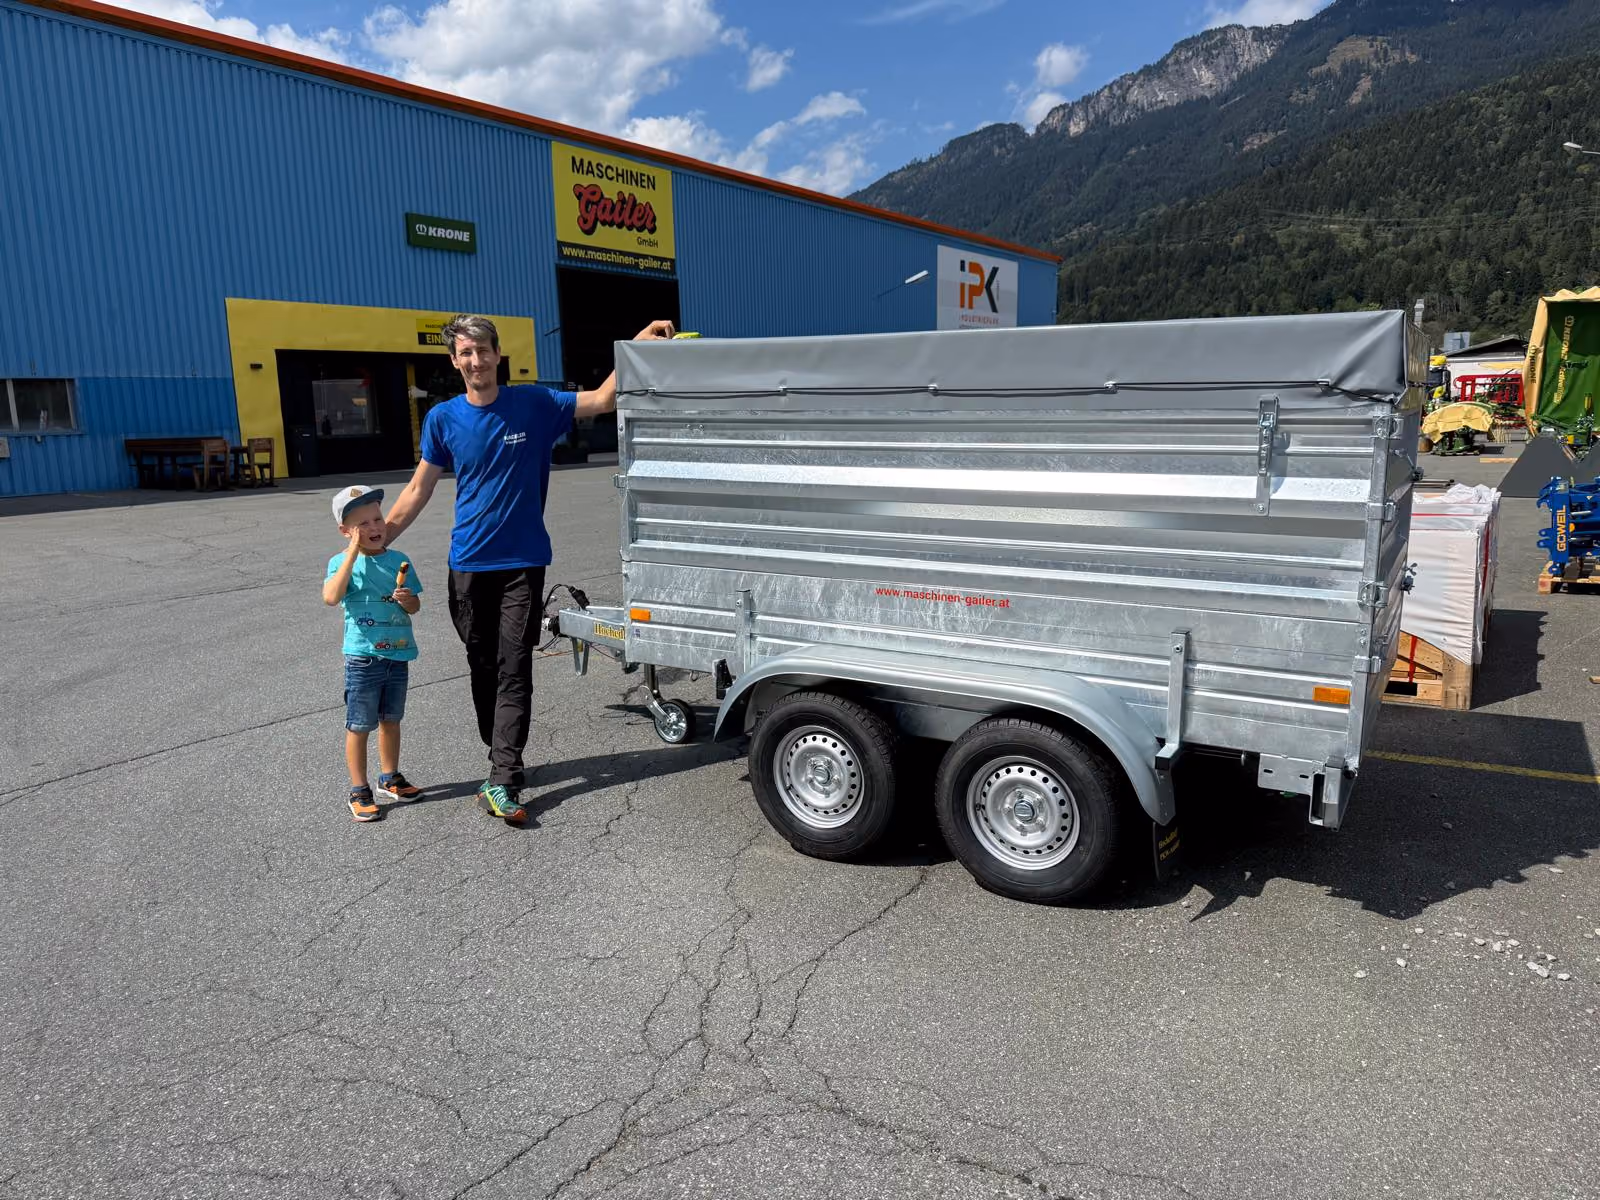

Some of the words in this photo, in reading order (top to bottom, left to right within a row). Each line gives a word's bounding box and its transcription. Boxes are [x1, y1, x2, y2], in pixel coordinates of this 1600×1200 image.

[571, 155, 656, 191] MASCHINEN
[573, 183, 657, 236] Gailer
[428, 226, 470, 242] KRONE
[637, 236, 659, 248] GmbH
[562, 245, 671, 270] www.maschinen-gailer.at
[875, 587, 1010, 608] www.maschinen-gailer.at
